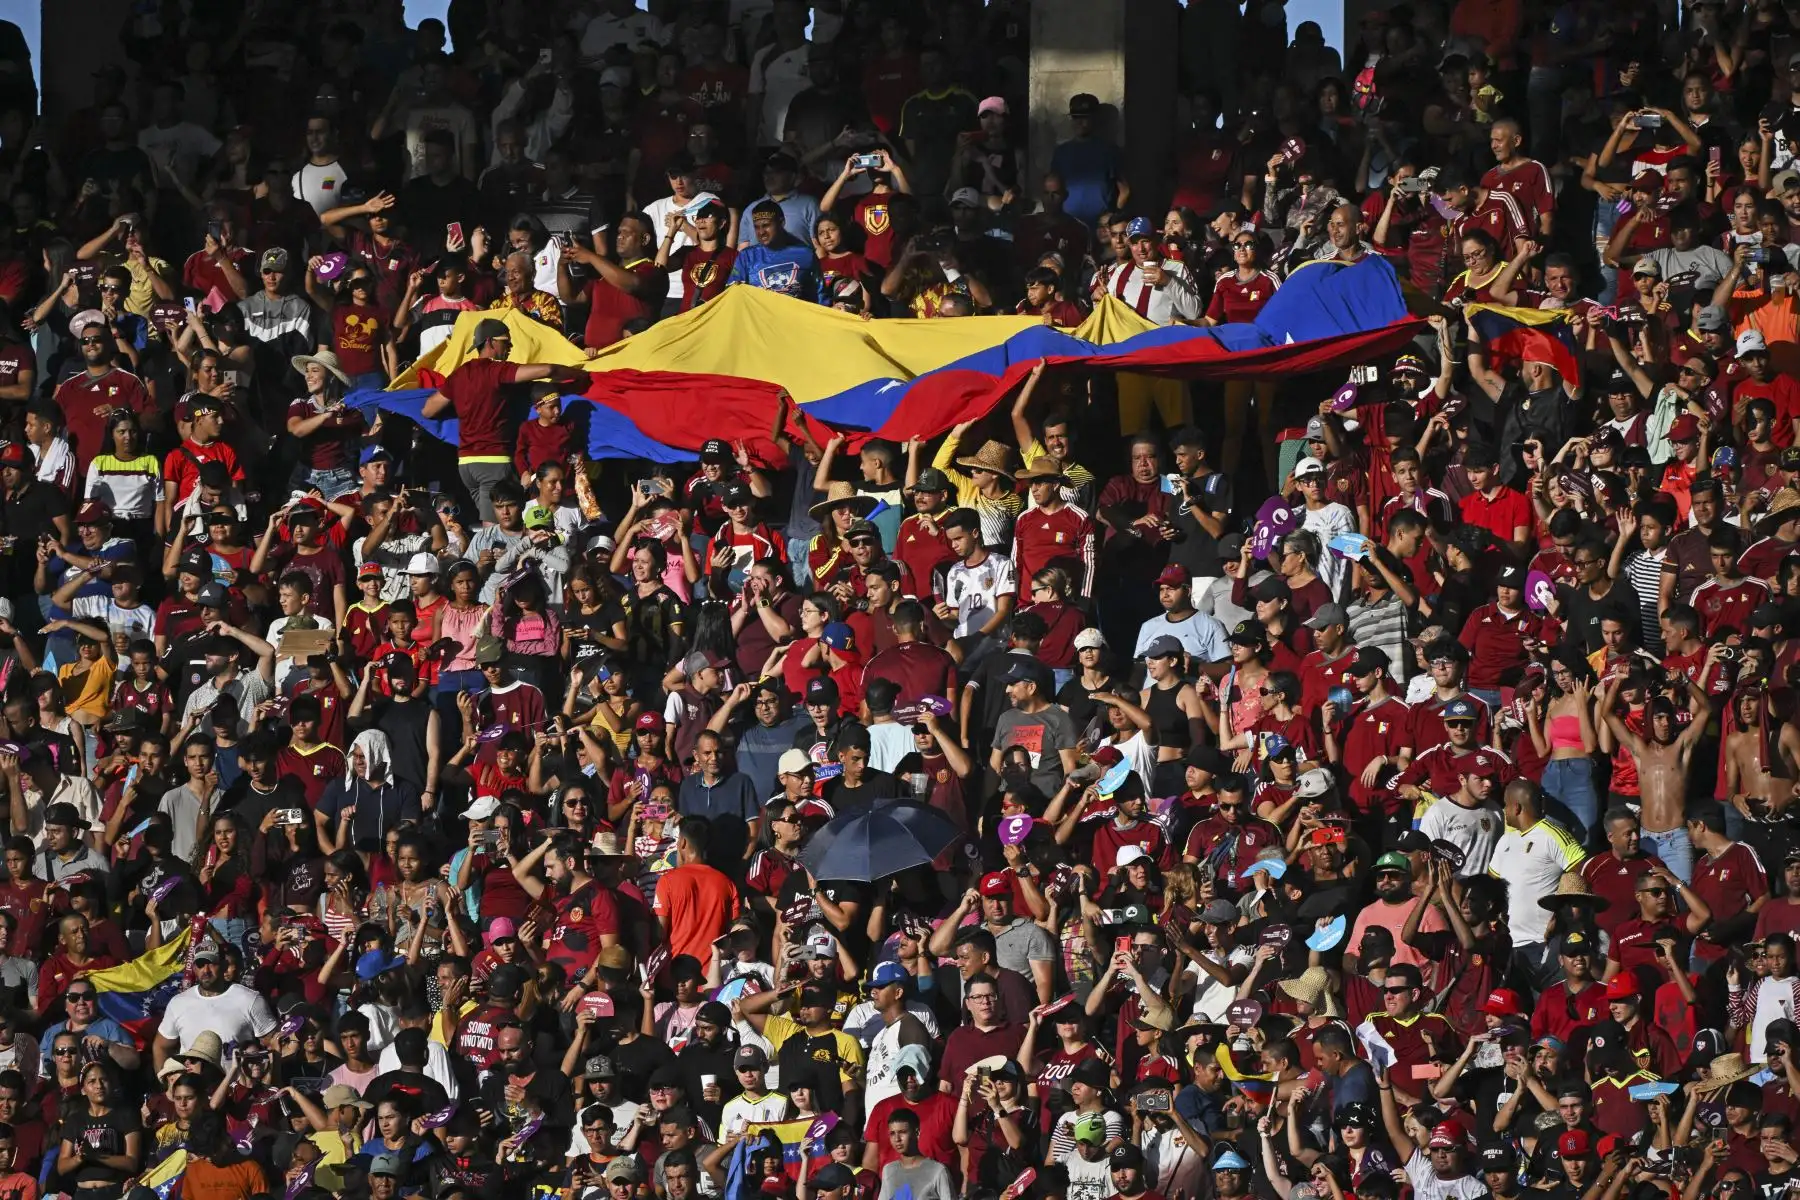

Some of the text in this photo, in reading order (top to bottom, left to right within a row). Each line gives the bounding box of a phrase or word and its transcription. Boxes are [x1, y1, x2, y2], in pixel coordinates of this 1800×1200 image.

[338, 335, 372, 352] Disney
[968, 593, 983, 610] 10
[467, 1021, 491, 1035] SOMOS
